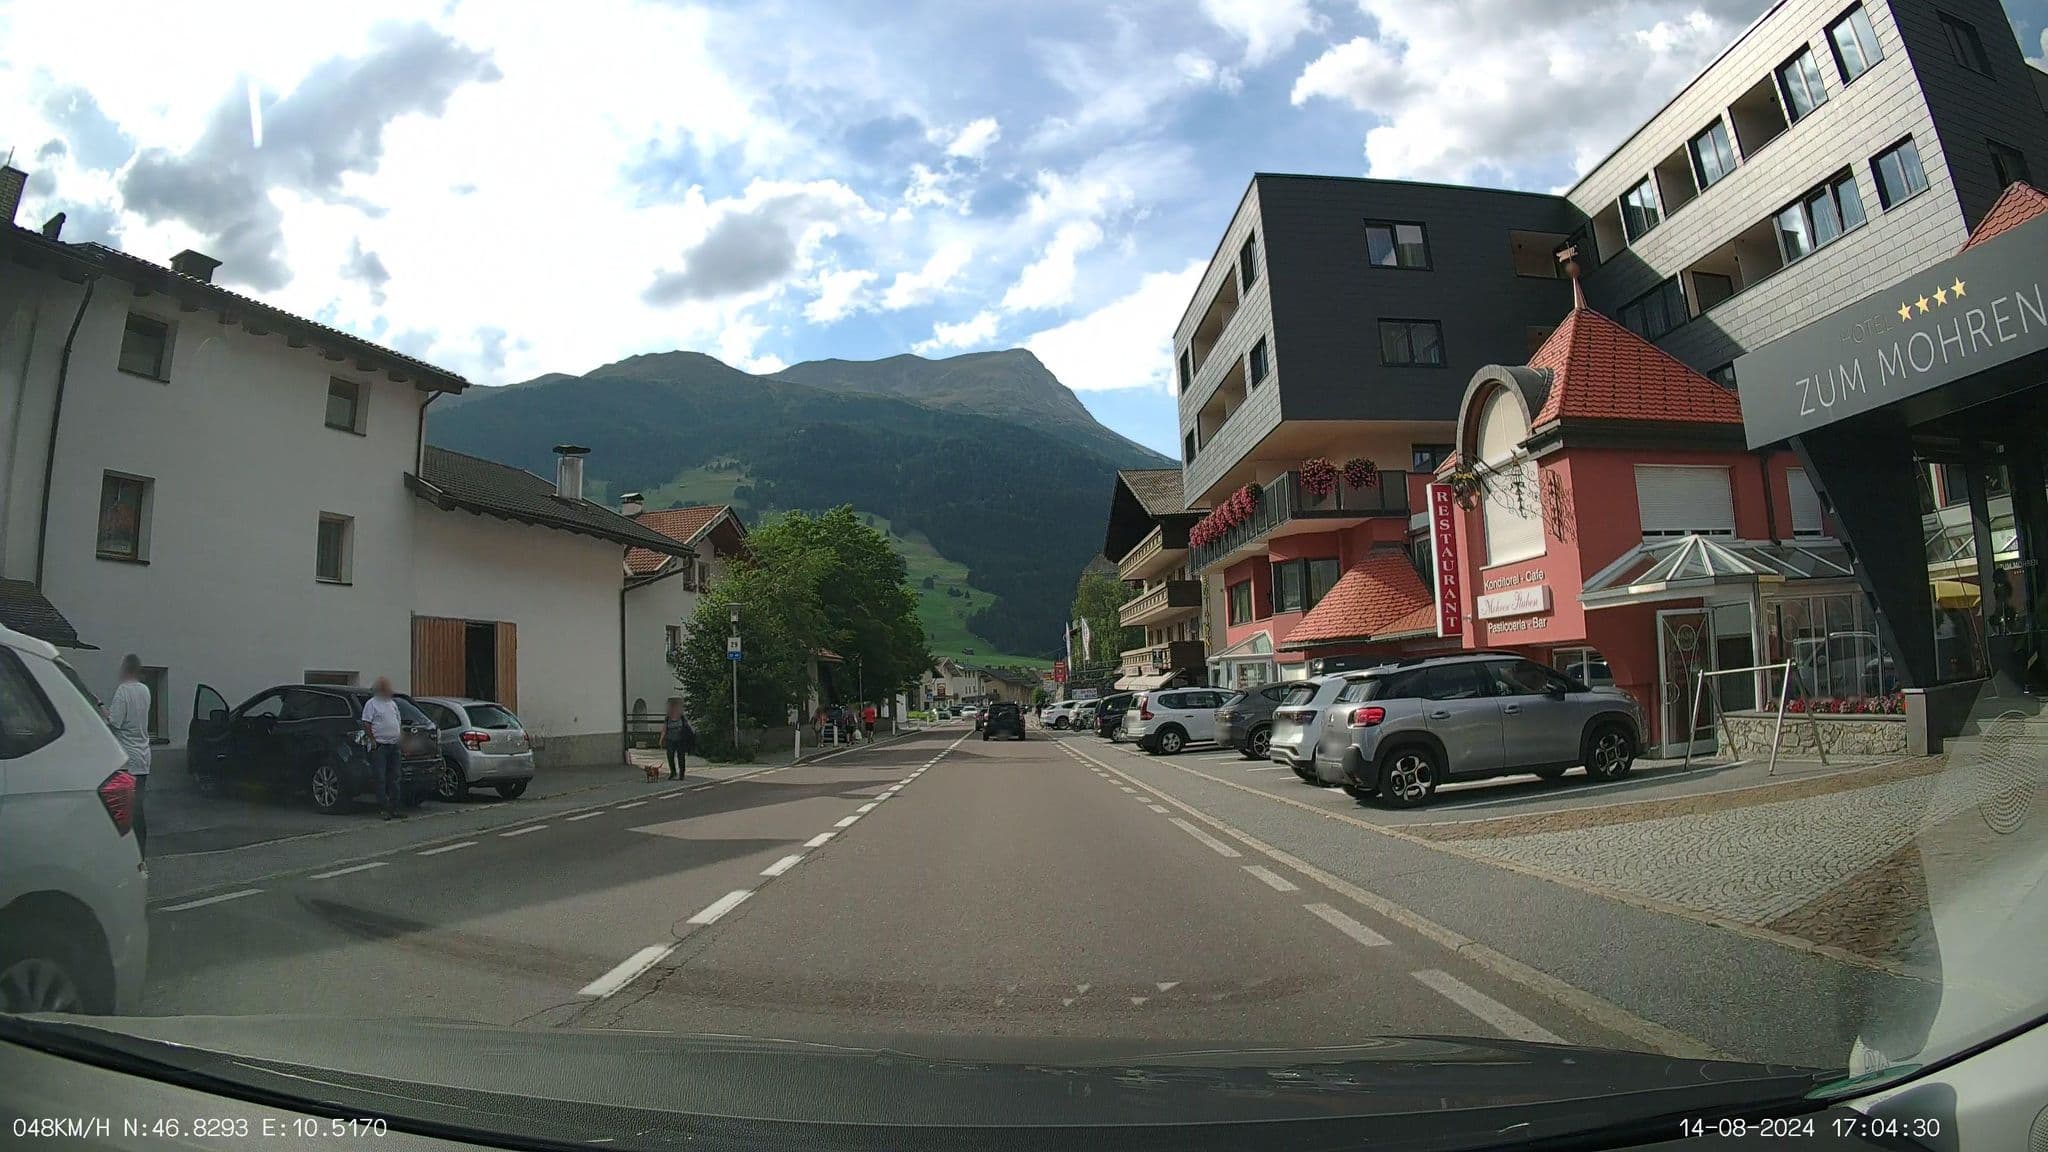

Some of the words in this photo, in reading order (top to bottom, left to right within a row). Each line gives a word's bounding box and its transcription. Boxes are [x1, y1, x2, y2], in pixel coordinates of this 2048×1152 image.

[1796, 358, 1866, 416] ZUM
[1878, 283, 2048, 386] MOHREN
[1437, 491, 1458, 628] RESTAURANT
[1488, 619, 1526, 633] Pasticceria
[1532, 616, 1547, 629] Bar
